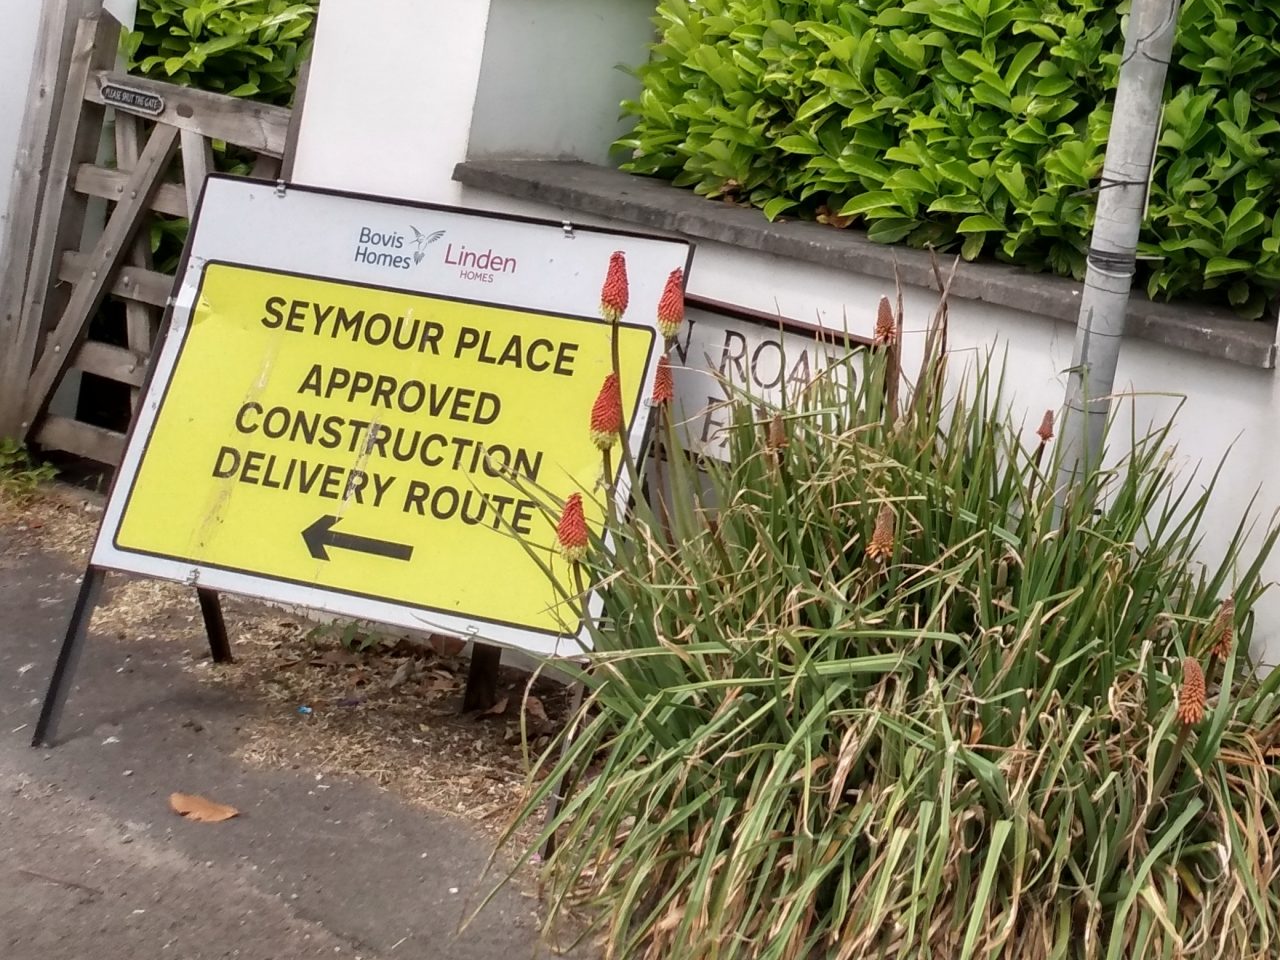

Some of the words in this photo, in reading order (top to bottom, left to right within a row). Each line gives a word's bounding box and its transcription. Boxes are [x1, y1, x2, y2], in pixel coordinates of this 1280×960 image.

[354, 245, 411, 269] Homes
[359, 226, 404, 249] Bovis
[444, 243, 517, 273] Linden
[459, 270, 494, 283] HOMES
[261, 296, 444, 355] SEYMOUR
[454, 327, 579, 376] PLACE
[297, 364, 501, 425] APPROVED
[235, 402, 543, 481] CONSTRUCTION
[212, 445, 396, 507] DELIVERY
[403, 480, 537, 534] ROUTE
